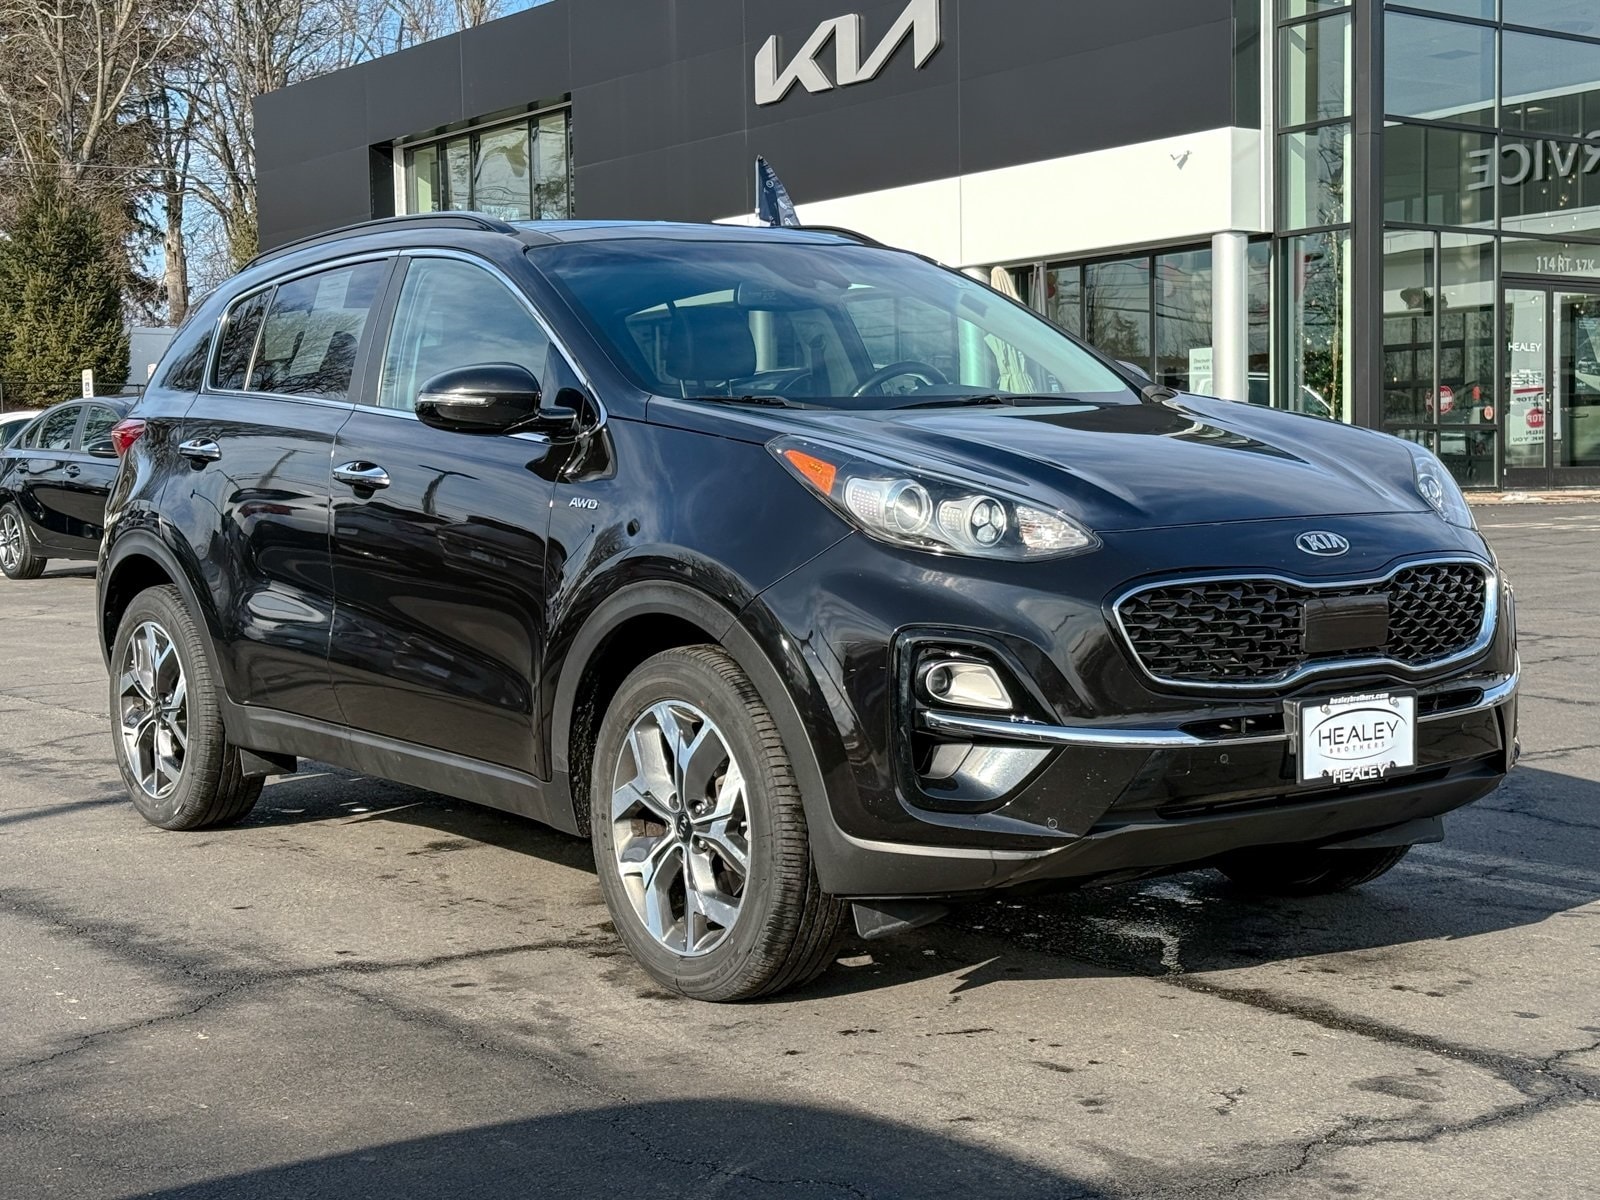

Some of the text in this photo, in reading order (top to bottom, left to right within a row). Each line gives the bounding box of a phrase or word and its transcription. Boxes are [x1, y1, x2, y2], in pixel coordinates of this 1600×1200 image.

[755, 0, 941, 105] KIA
[1536, 256, 1556, 272] 114
[1575, 258, 1595, 271] 17K
[1508, 342, 1542, 352] HEALEY
[568, 497, 598, 510] AWD
[1303, 533, 1345, 551] KIA
[1329, 692, 1389, 705] healeybrothers.com
[1318, 719, 1399, 748] HEALEY
[1329, 741, 1385, 754] BROTHERS
[1332, 764, 1387, 784] HEALEY
